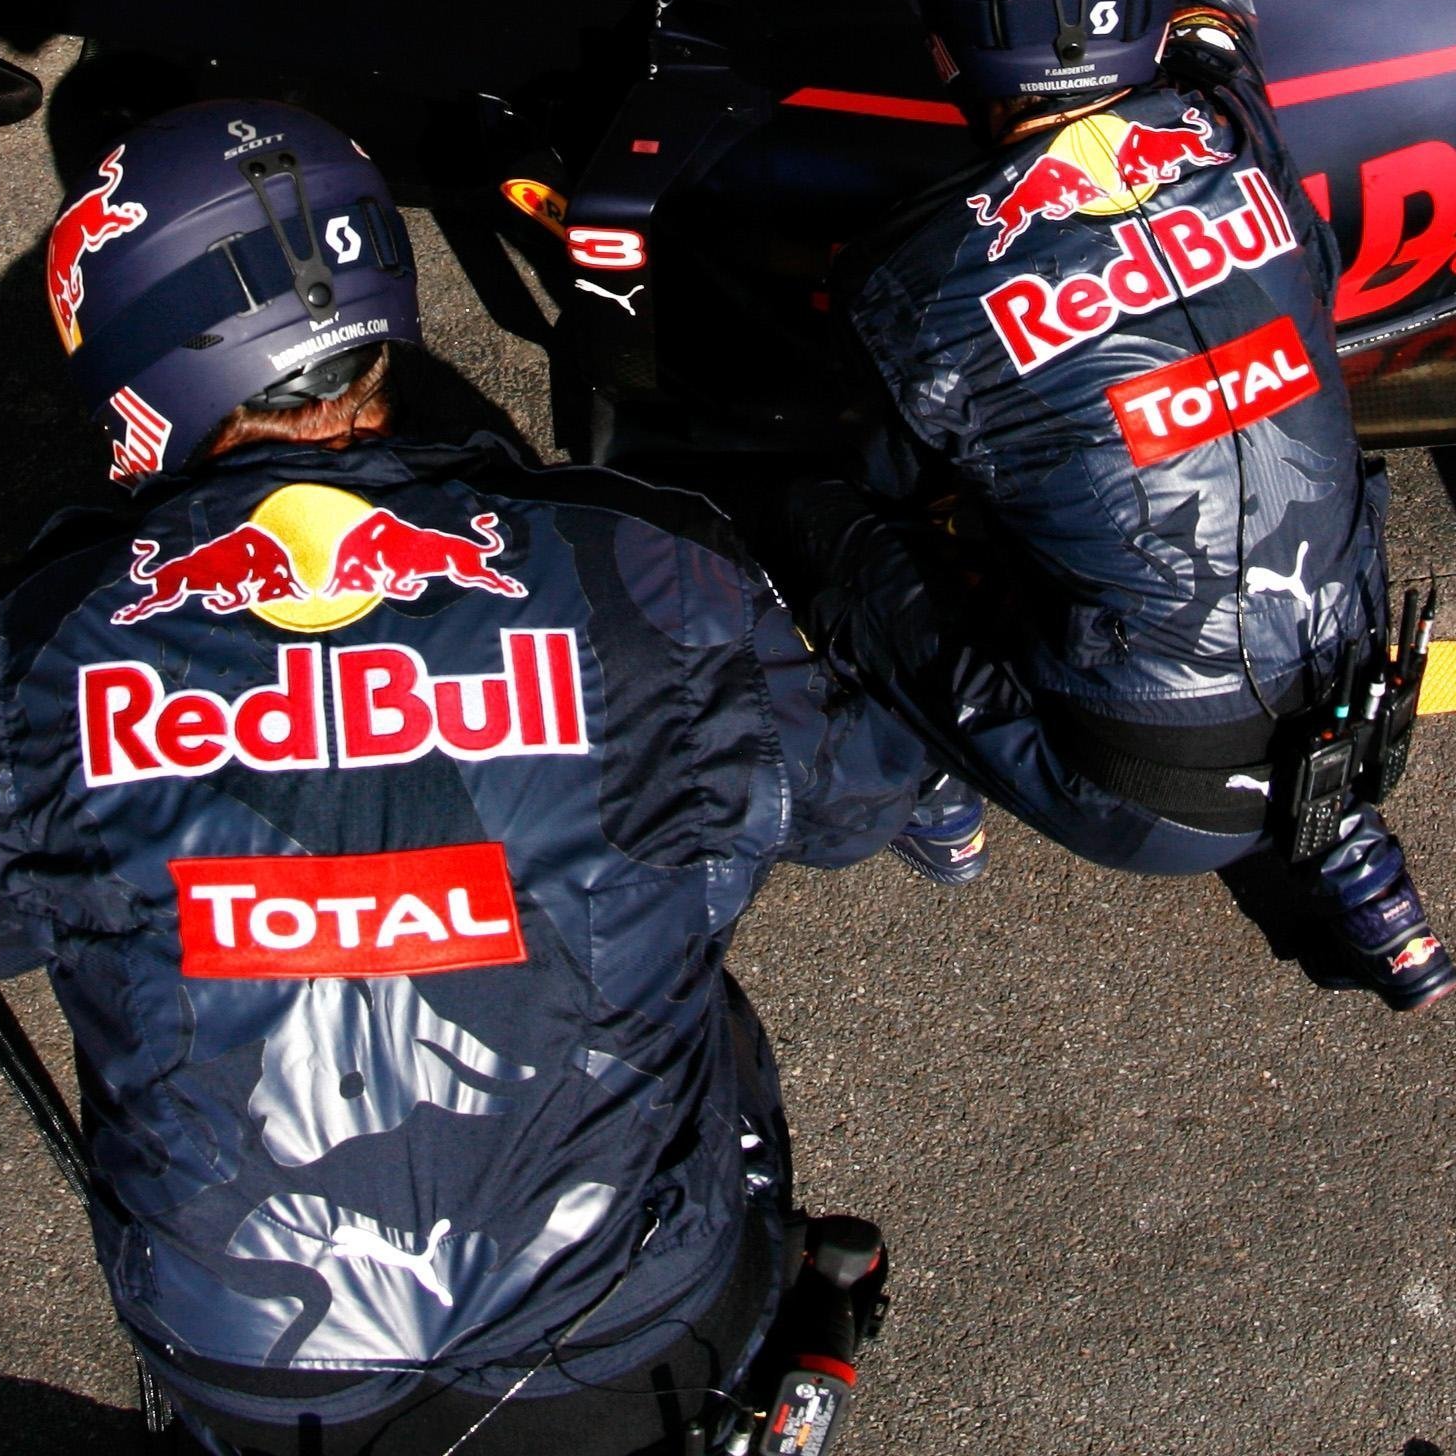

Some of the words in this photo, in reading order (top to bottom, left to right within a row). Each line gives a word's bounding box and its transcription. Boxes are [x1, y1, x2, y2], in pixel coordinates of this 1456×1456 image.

[1019, 74, 1119, 93] REDBULLRACING.COM
[223, 133, 285, 161] SCOTT
[566, 225, 648, 271] 3
[271, 318, 390, 371] REDBULLRACING.COM
[1123, 349, 1309, 440] TOTAL
[191, 881, 511, 952] TOTAL
